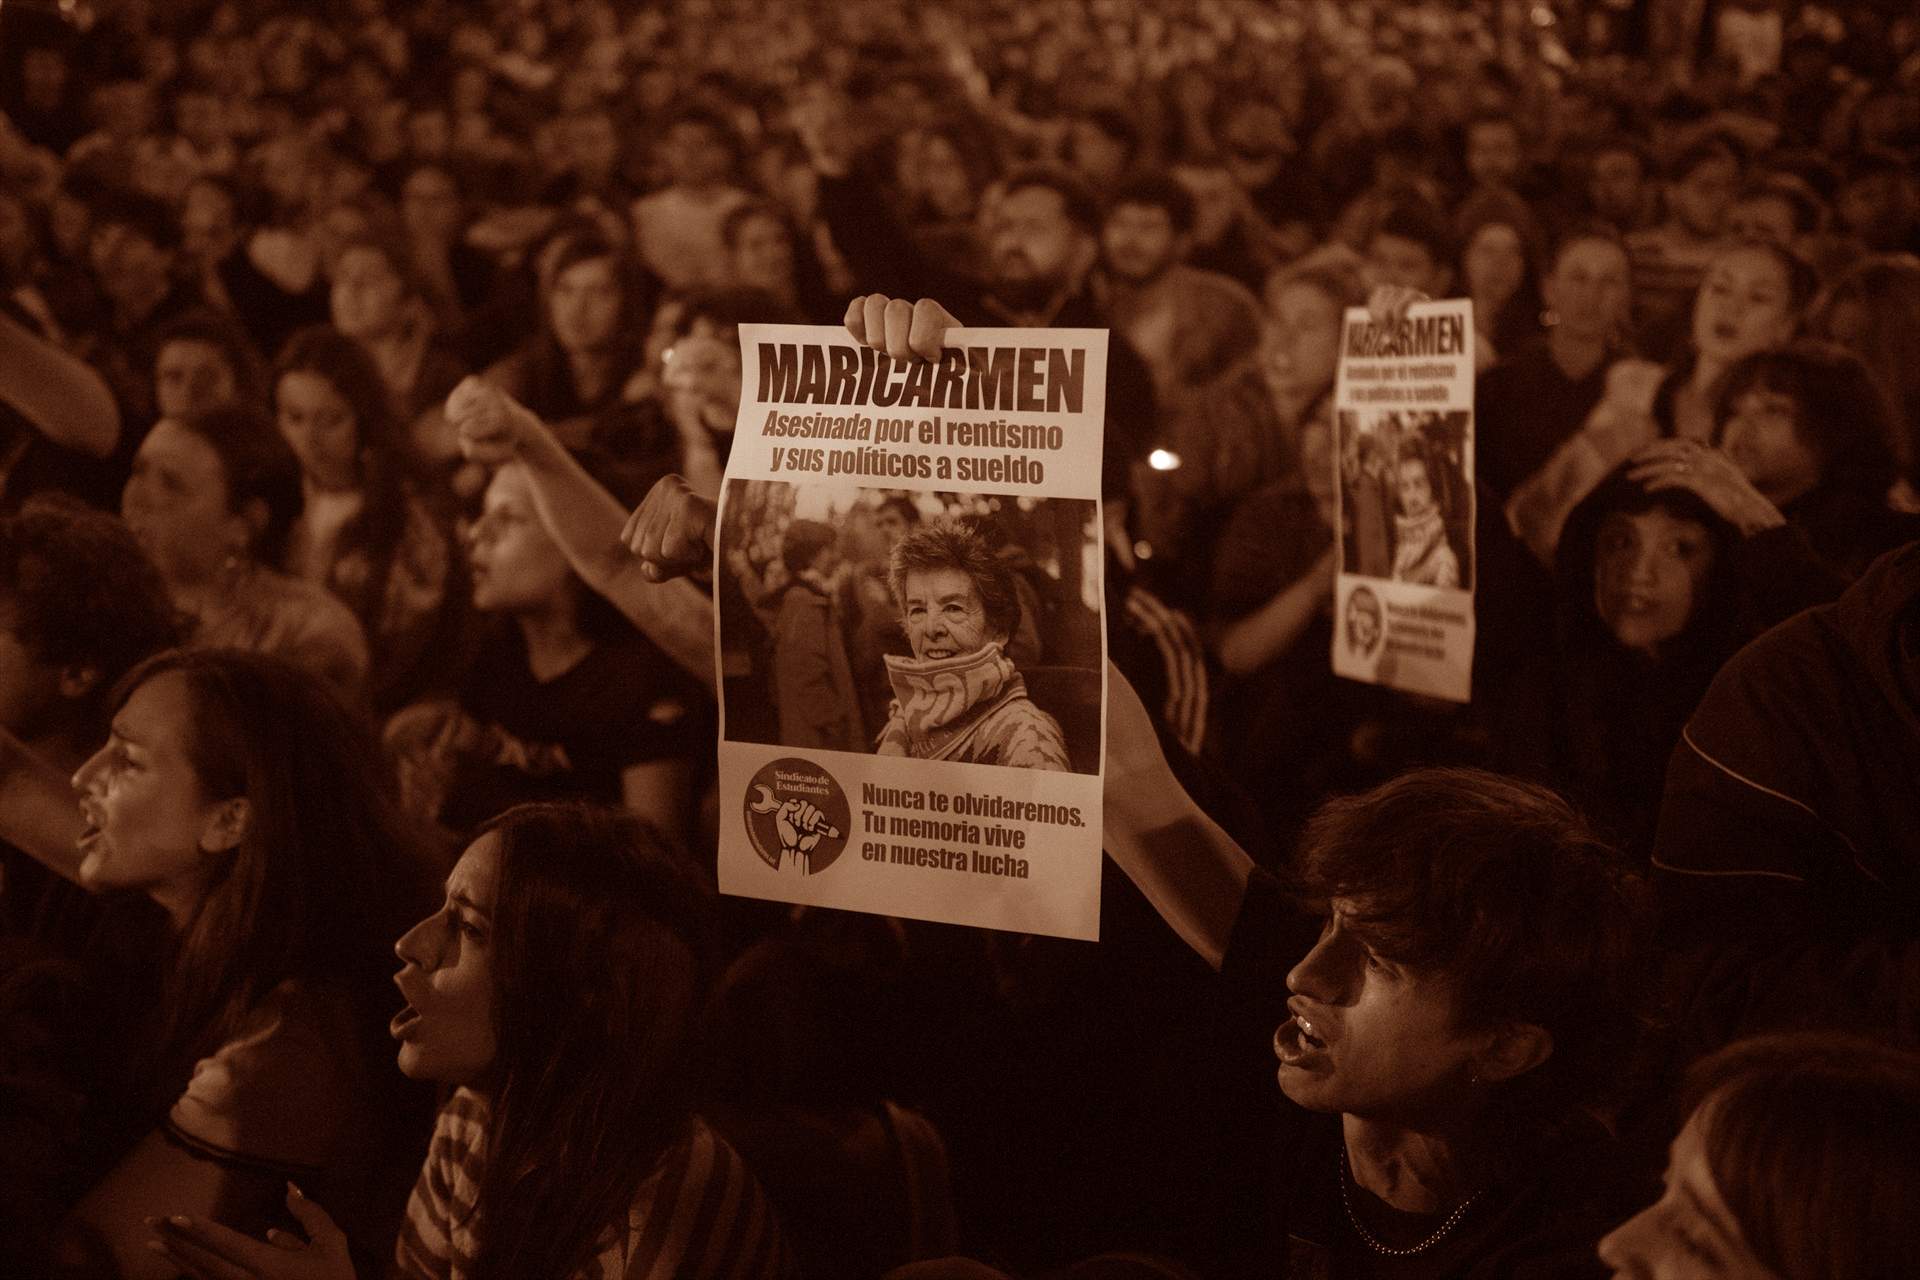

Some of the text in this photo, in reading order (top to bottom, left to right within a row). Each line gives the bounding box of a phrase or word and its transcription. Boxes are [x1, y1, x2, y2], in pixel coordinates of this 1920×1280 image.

[757, 343, 1086, 413] MARICARMEN
[762, 410, 1063, 450] Asesinada por el rentismo
[770, 445, 1044, 485] y sus políticos a sueldo
[775, 770, 830, 785] Sindicato de
[776, 781, 830, 795] Estudiantes
[862, 782, 1086, 827] Nunca te olvidaremos.
[862, 810, 1026, 850] Tu memoria vive
[861, 841, 1029, 879] en nuestra lucha
